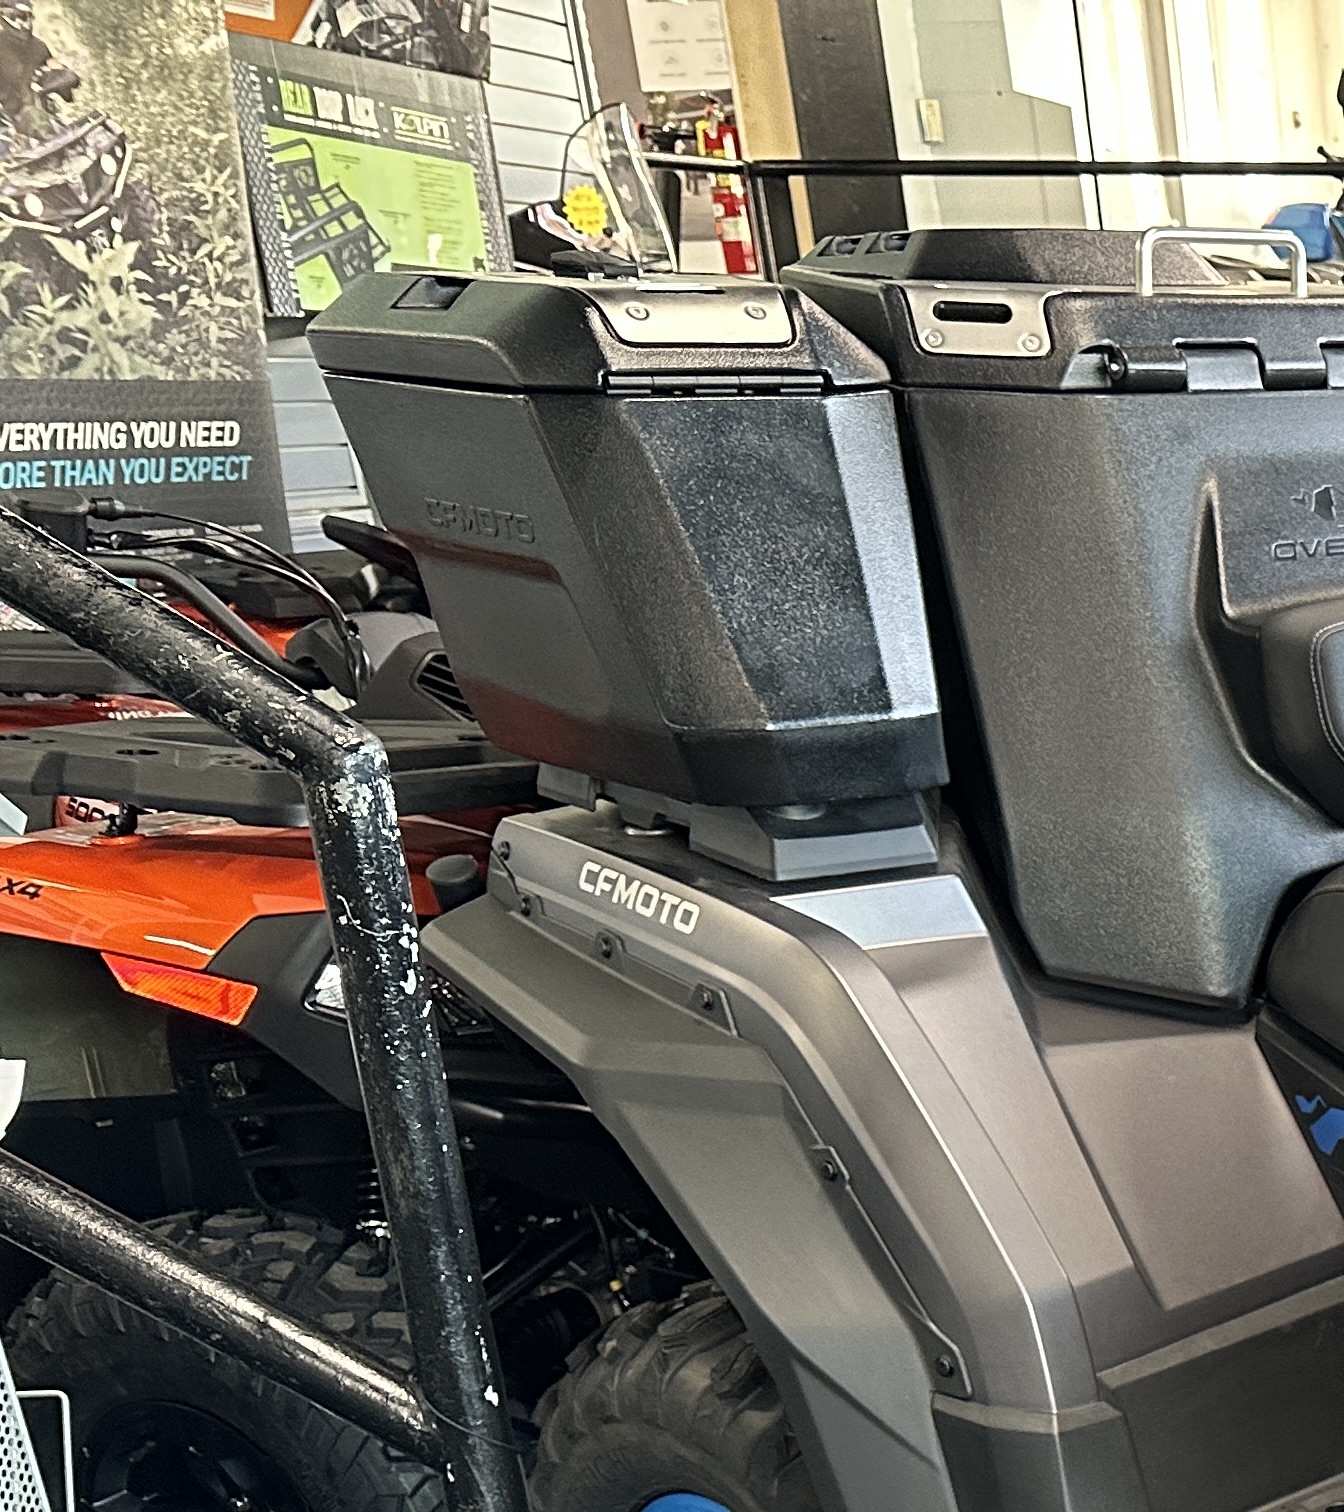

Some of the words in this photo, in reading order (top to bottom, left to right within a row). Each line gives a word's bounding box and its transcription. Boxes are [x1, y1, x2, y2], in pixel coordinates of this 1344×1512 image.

[130, 420, 176, 449] YOU
[180, 420, 241, 448] NEED
[50, 457, 115, 487] THAN
[120, 456, 166, 485] YOU
[170, 455, 253, 483] EXPECT
[0, 875, 44, 900] X4
[578, 860, 700, 935] CFMOTO
